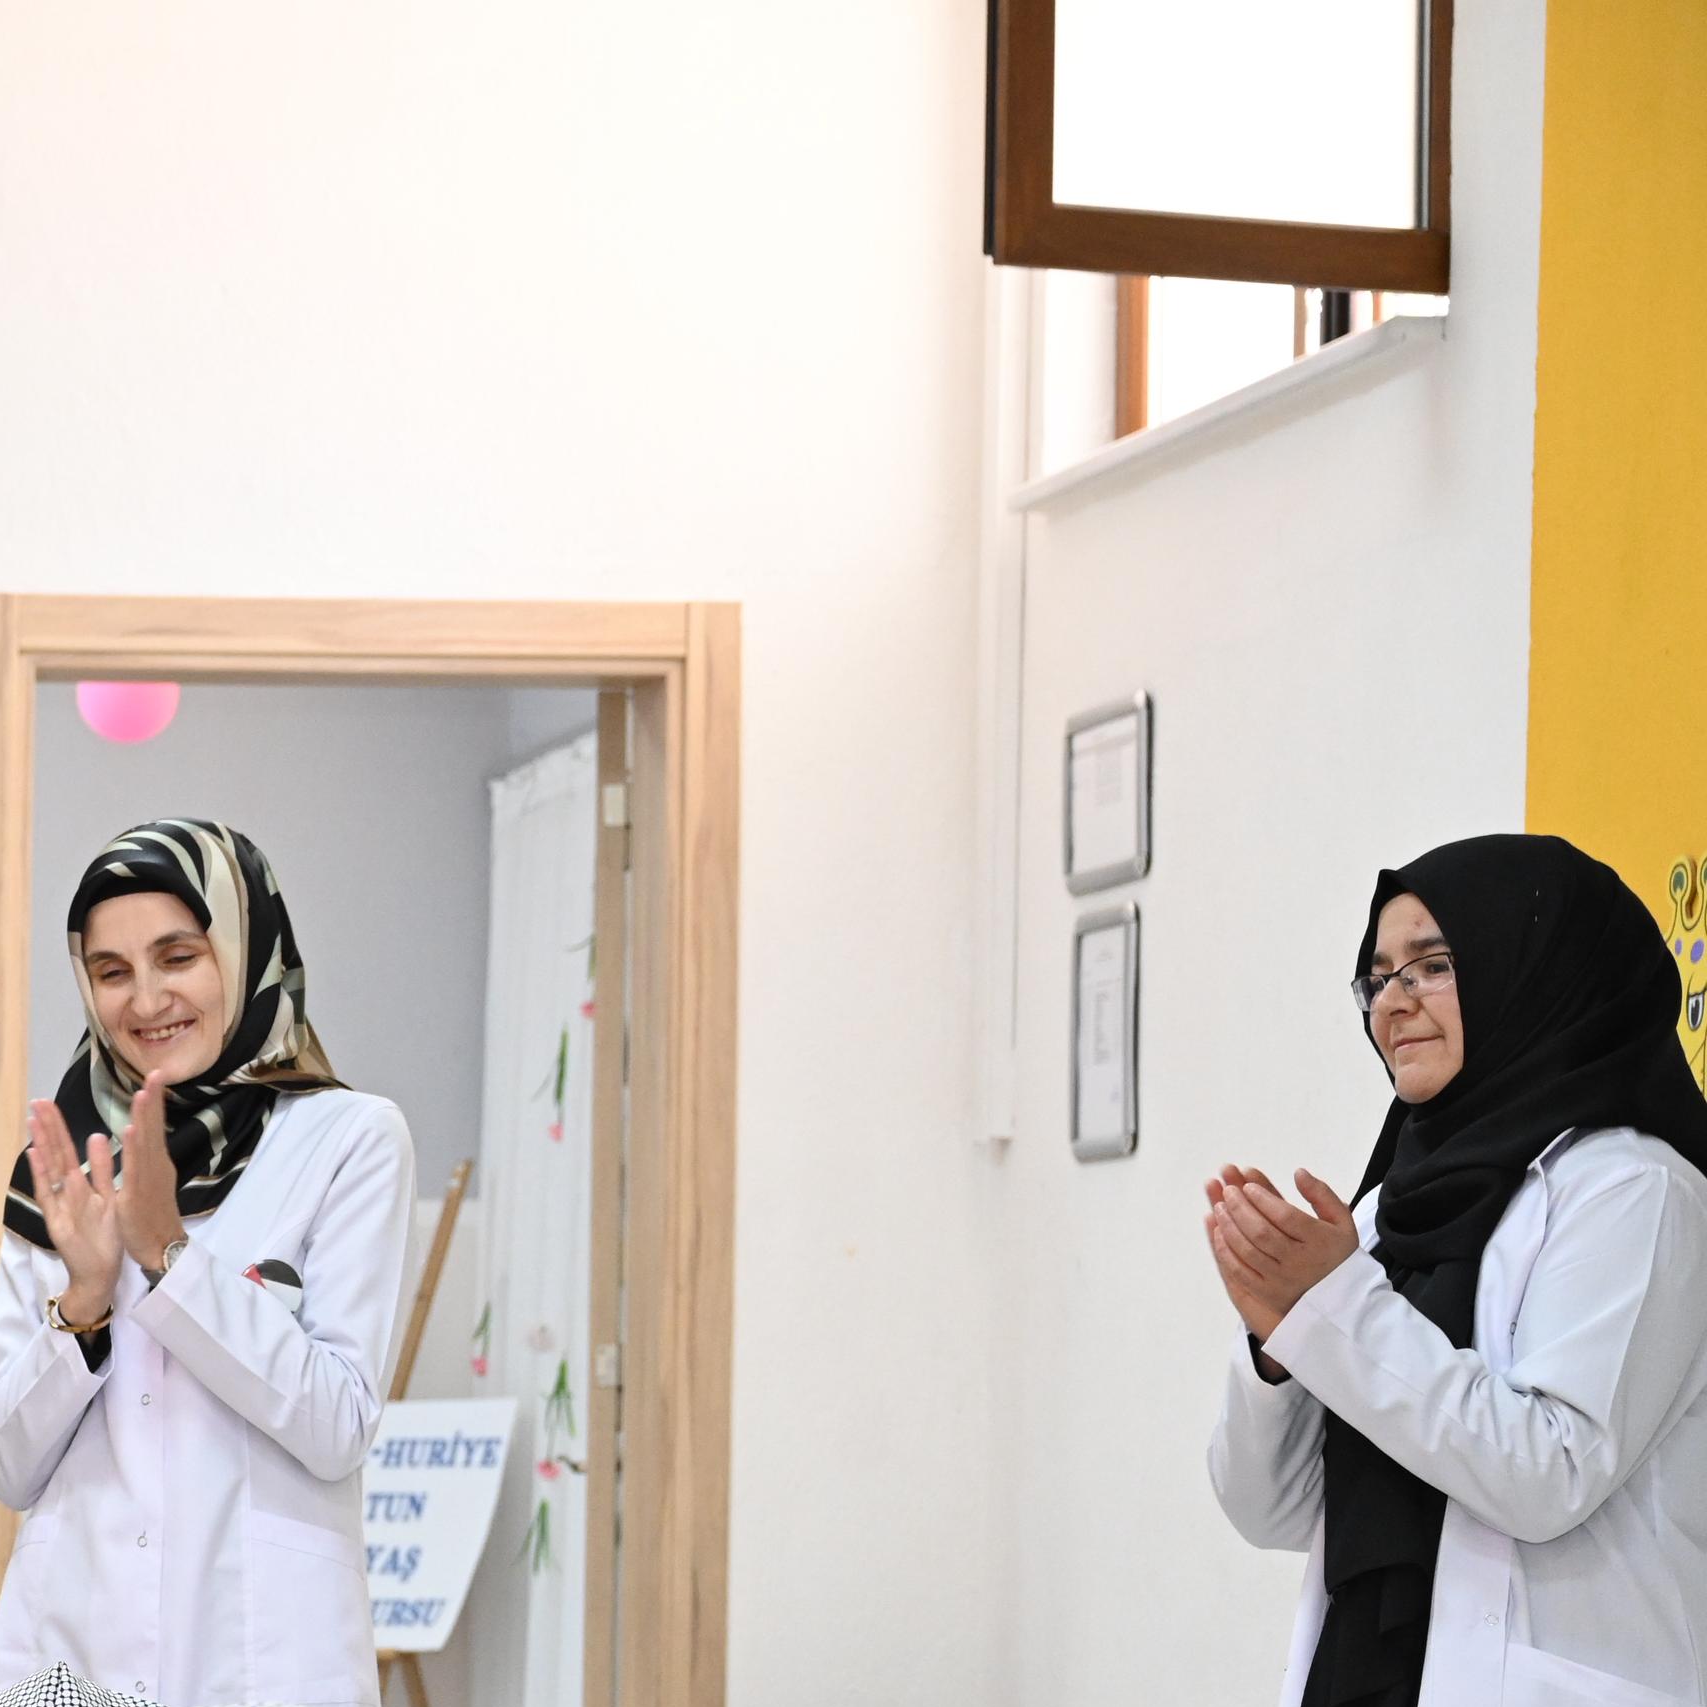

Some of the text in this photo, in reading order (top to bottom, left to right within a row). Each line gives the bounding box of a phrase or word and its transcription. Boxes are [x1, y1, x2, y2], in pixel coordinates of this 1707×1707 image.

[371, 1430, 500, 1467] -HURİYE
[365, 1490, 428, 1523] TUN
[370, 1597, 446, 1628] URSU
